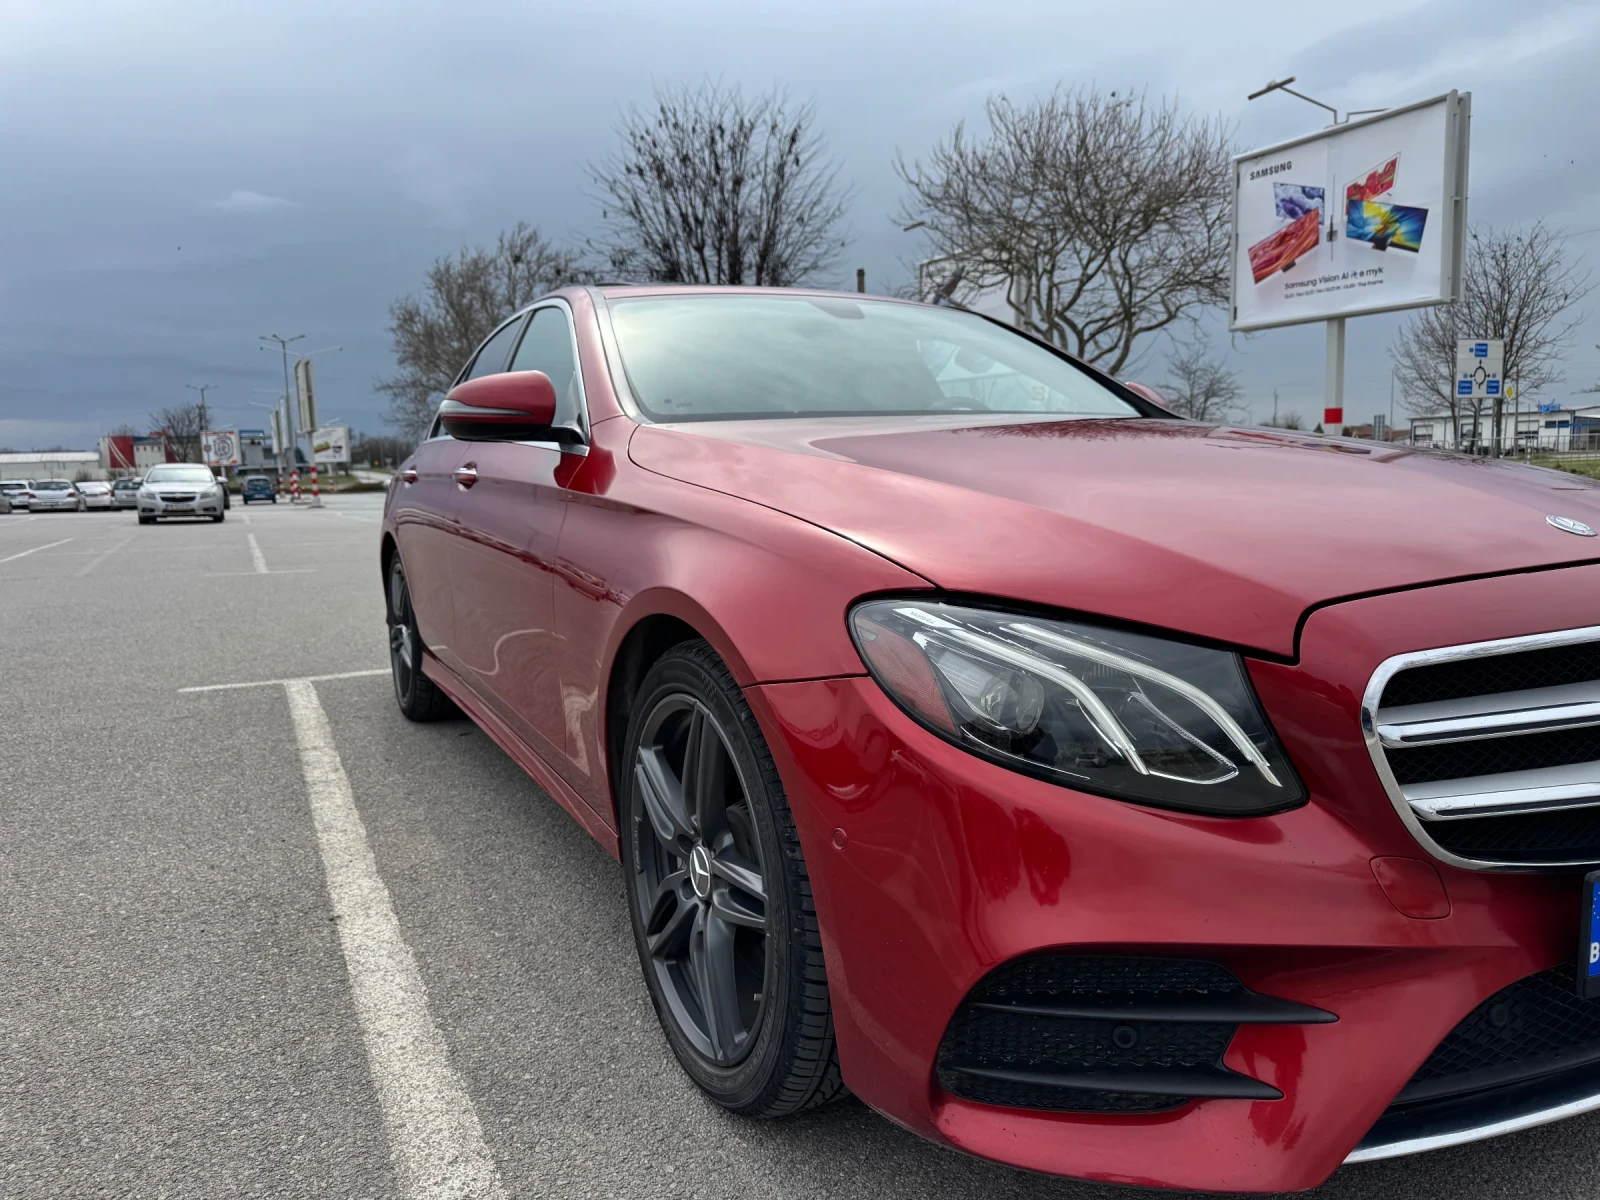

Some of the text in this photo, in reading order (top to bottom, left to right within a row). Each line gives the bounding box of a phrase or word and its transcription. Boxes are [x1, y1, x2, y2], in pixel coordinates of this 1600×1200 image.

[1250, 161, 1292, 180] SAMSUNG
[1284, 278, 1317, 289] Samsung
[1319, 275, 1339, 284] Vision
